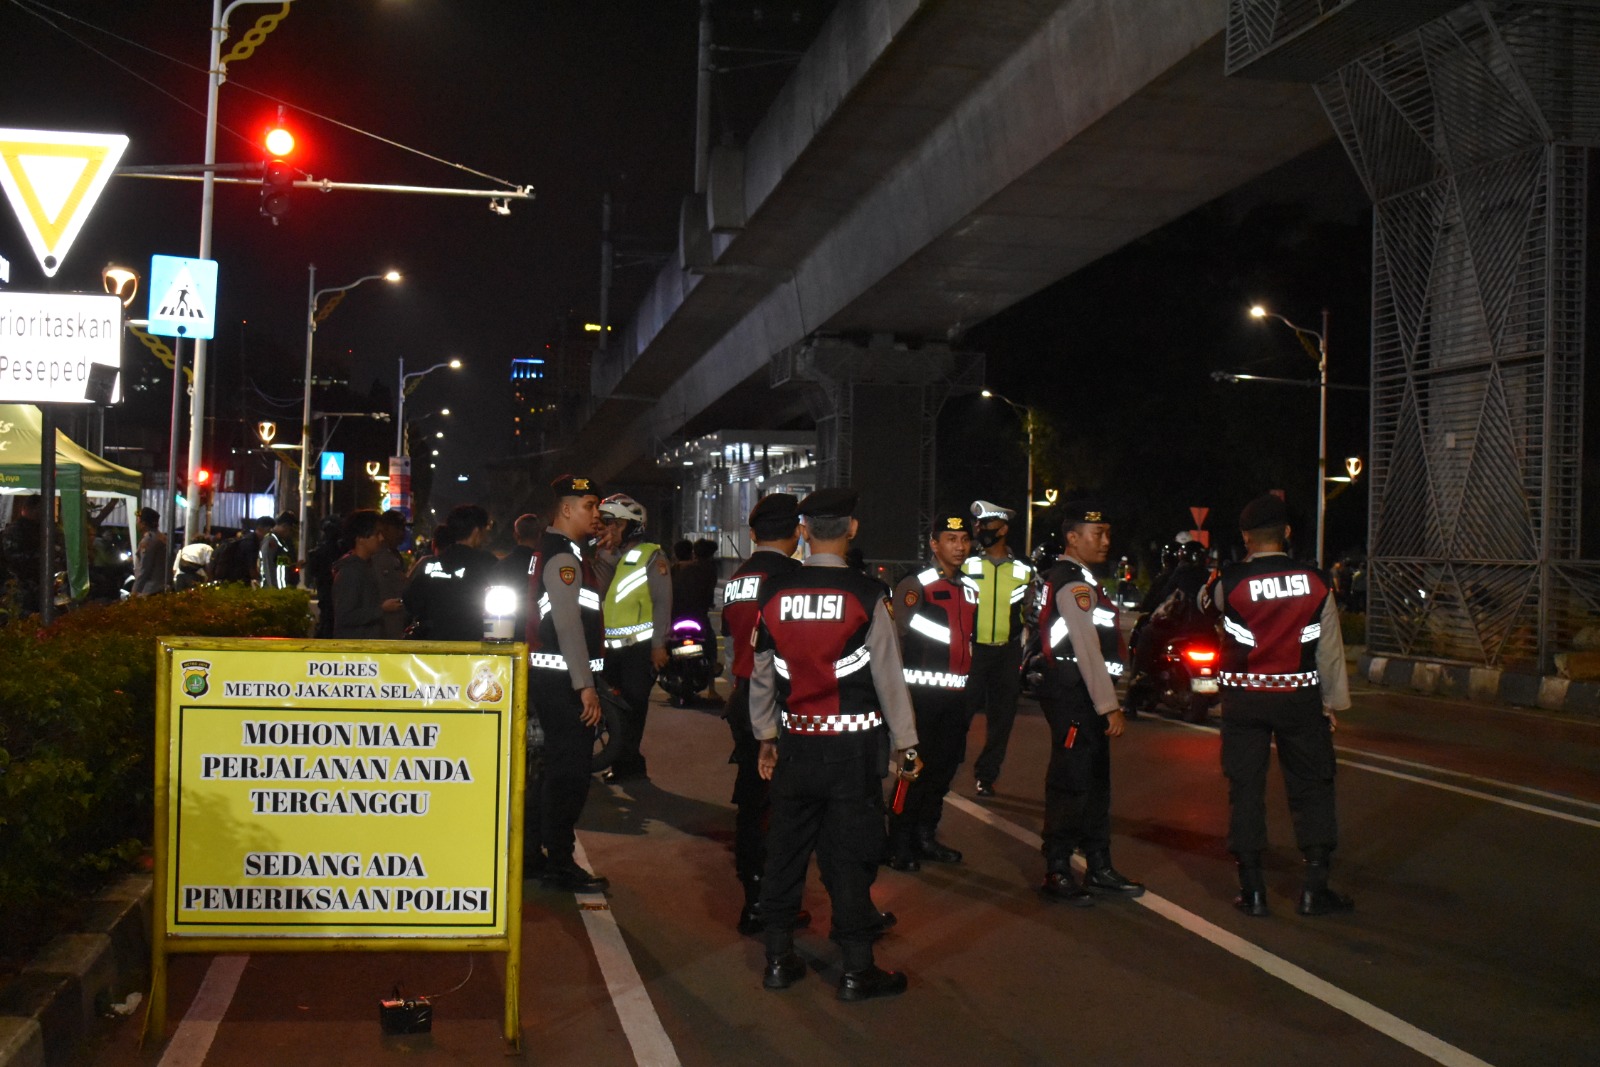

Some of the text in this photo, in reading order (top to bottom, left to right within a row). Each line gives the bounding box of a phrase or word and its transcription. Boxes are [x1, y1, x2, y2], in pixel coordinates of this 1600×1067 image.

[0, 309, 112, 339] rioritaskan
[0, 356, 86, 388] Peseped
[724, 577, 760, 603] POLISI
[1249, 574, 1310, 601] POLISI
[780, 595, 843, 620] POLISI
[309, 662, 378, 677] POLRES
[224, 683, 459, 699] METRO JAKARTA SELATAN
[244, 723, 438, 747] MOHON MAAF
[203, 757, 471, 781] PERJALANAN ANDA
[251, 791, 429, 814] TERGANGGU
[245, 854, 425, 877] SEDANG ADA
[183, 887, 488, 911] PEMERIKSAAN POLISI
